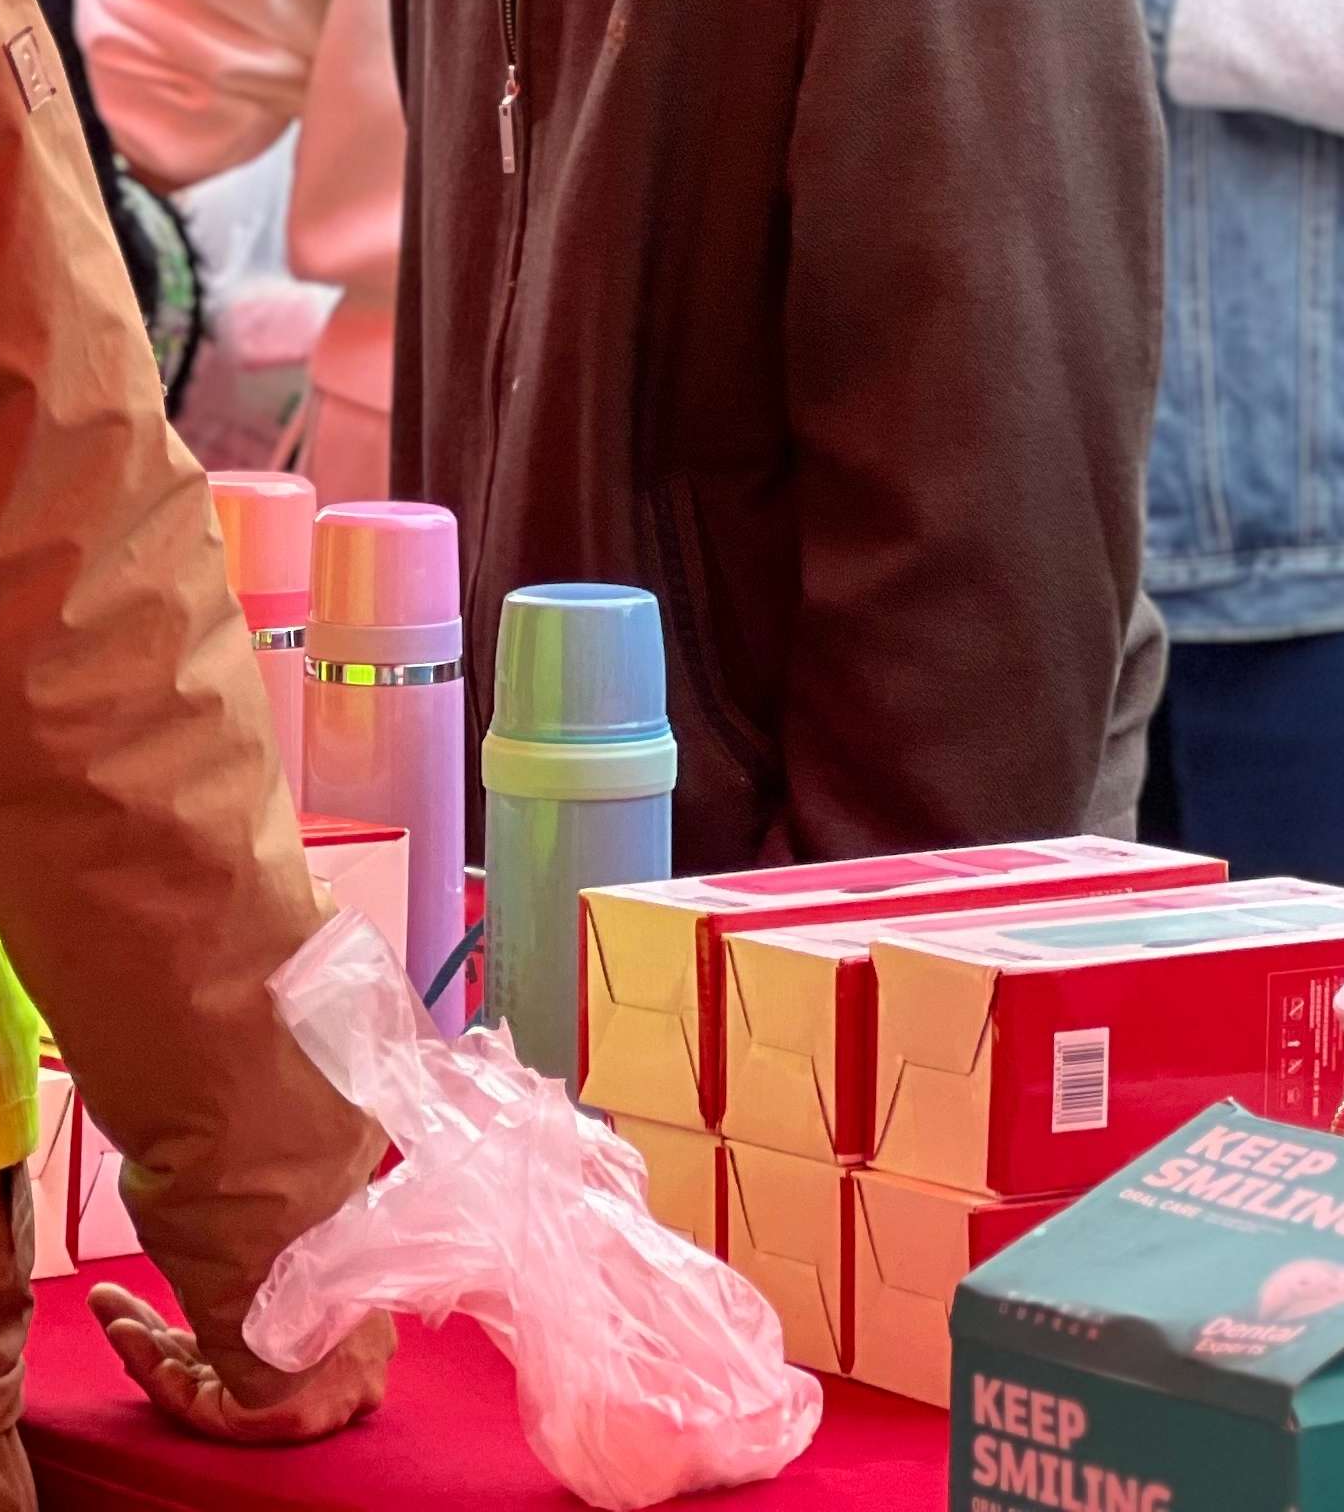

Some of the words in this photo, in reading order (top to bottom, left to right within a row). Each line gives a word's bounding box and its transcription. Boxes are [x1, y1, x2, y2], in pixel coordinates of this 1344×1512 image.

[1185, 1125, 1338, 1180] KEEP
[1201, 1317, 1305, 1343] Dental
[971, 1373, 1087, 1451] KEEP
